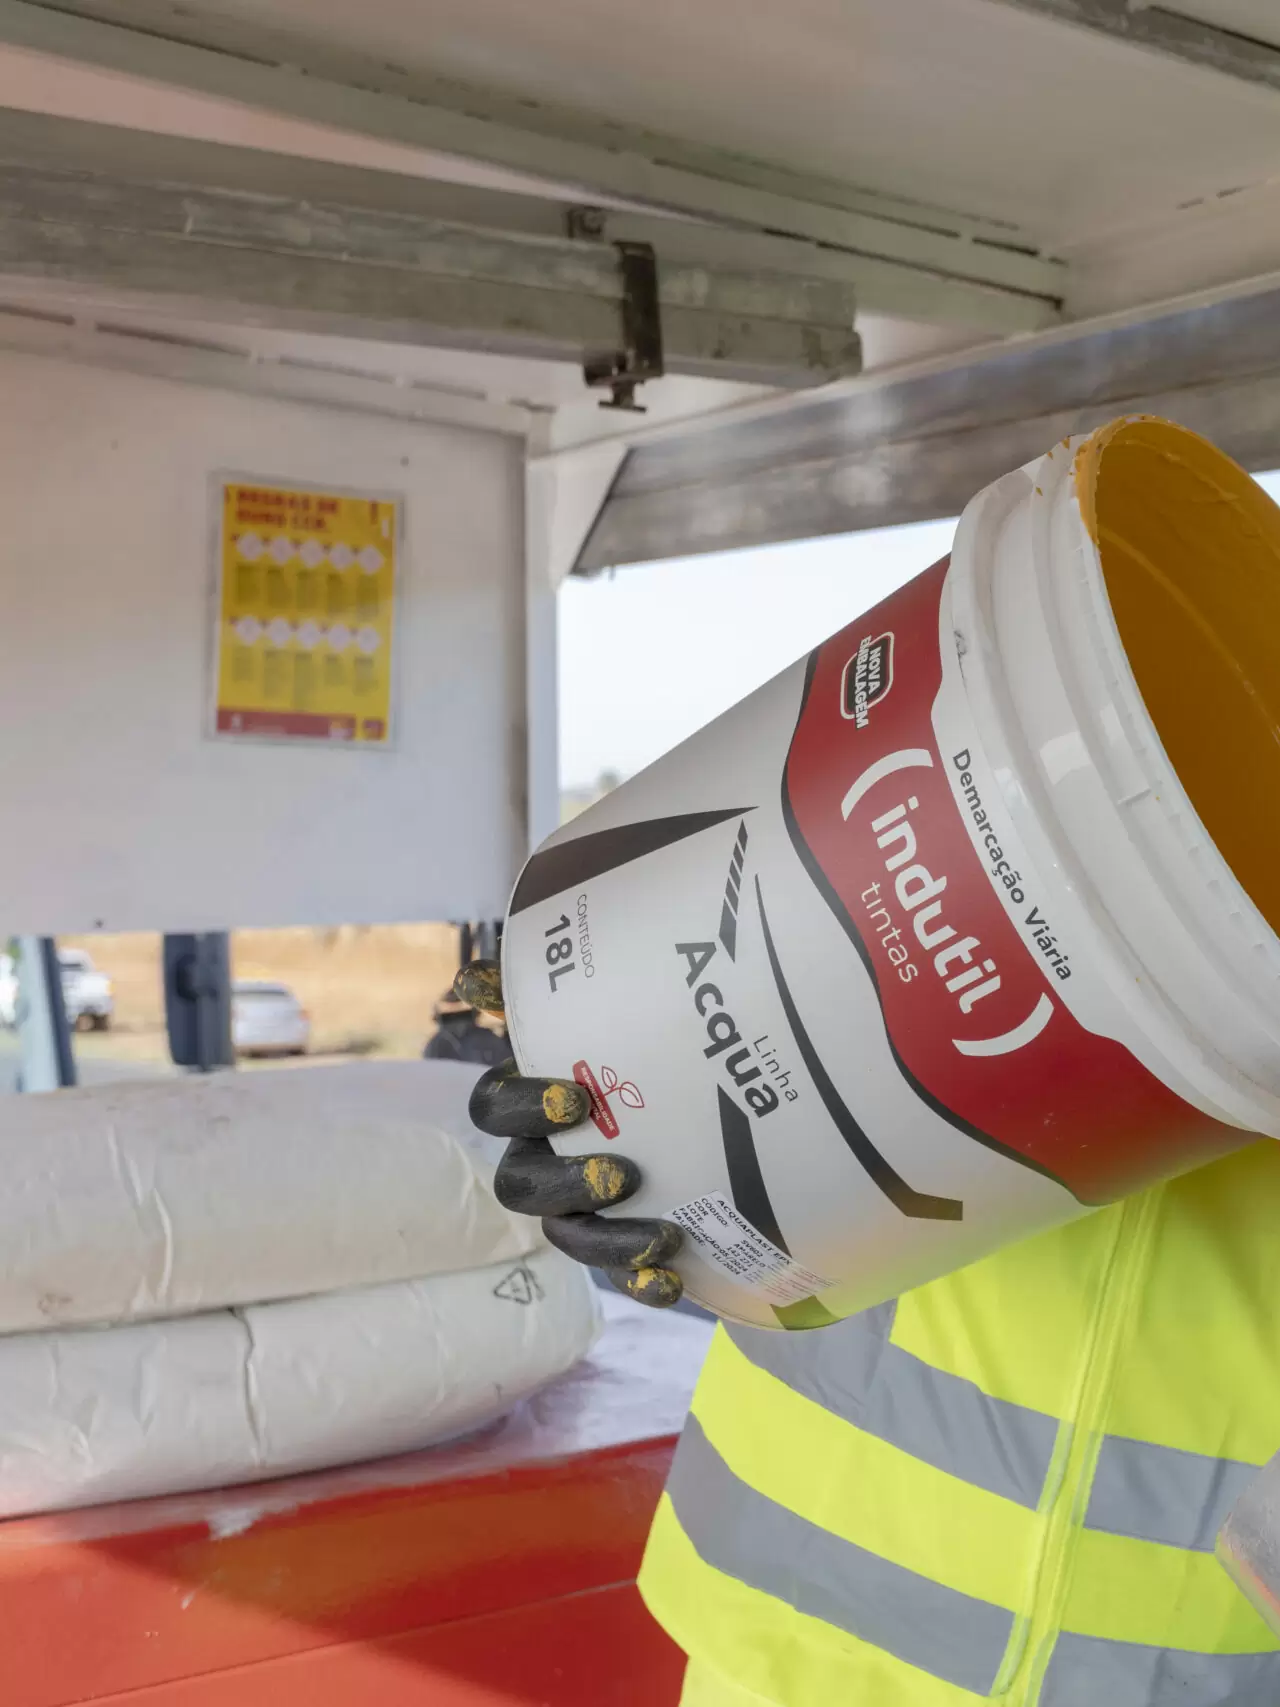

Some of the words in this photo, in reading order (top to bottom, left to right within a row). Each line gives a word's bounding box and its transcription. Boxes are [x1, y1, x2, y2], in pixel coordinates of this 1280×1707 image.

[855, 635, 872, 729] EMBALAGEM
[868, 646, 882, 695] NOVA
[952, 748, 1026, 905] Demarcação
[1024, 906, 1072, 981] Viária
[544, 913, 576, 993] 18L
[576, 893, 595, 979] CONTEÚDO
[860, 881, 919, 984] tintas
[675, 941, 780, 1119] Acqua
[753, 1035, 799, 1102] Linha
[580, 1067, 615, 1131] RESPONSABILIDADE
[717, 1199, 774, 1252] ACQUAPLAST
[733, 1243, 766, 1268] AMARELO
